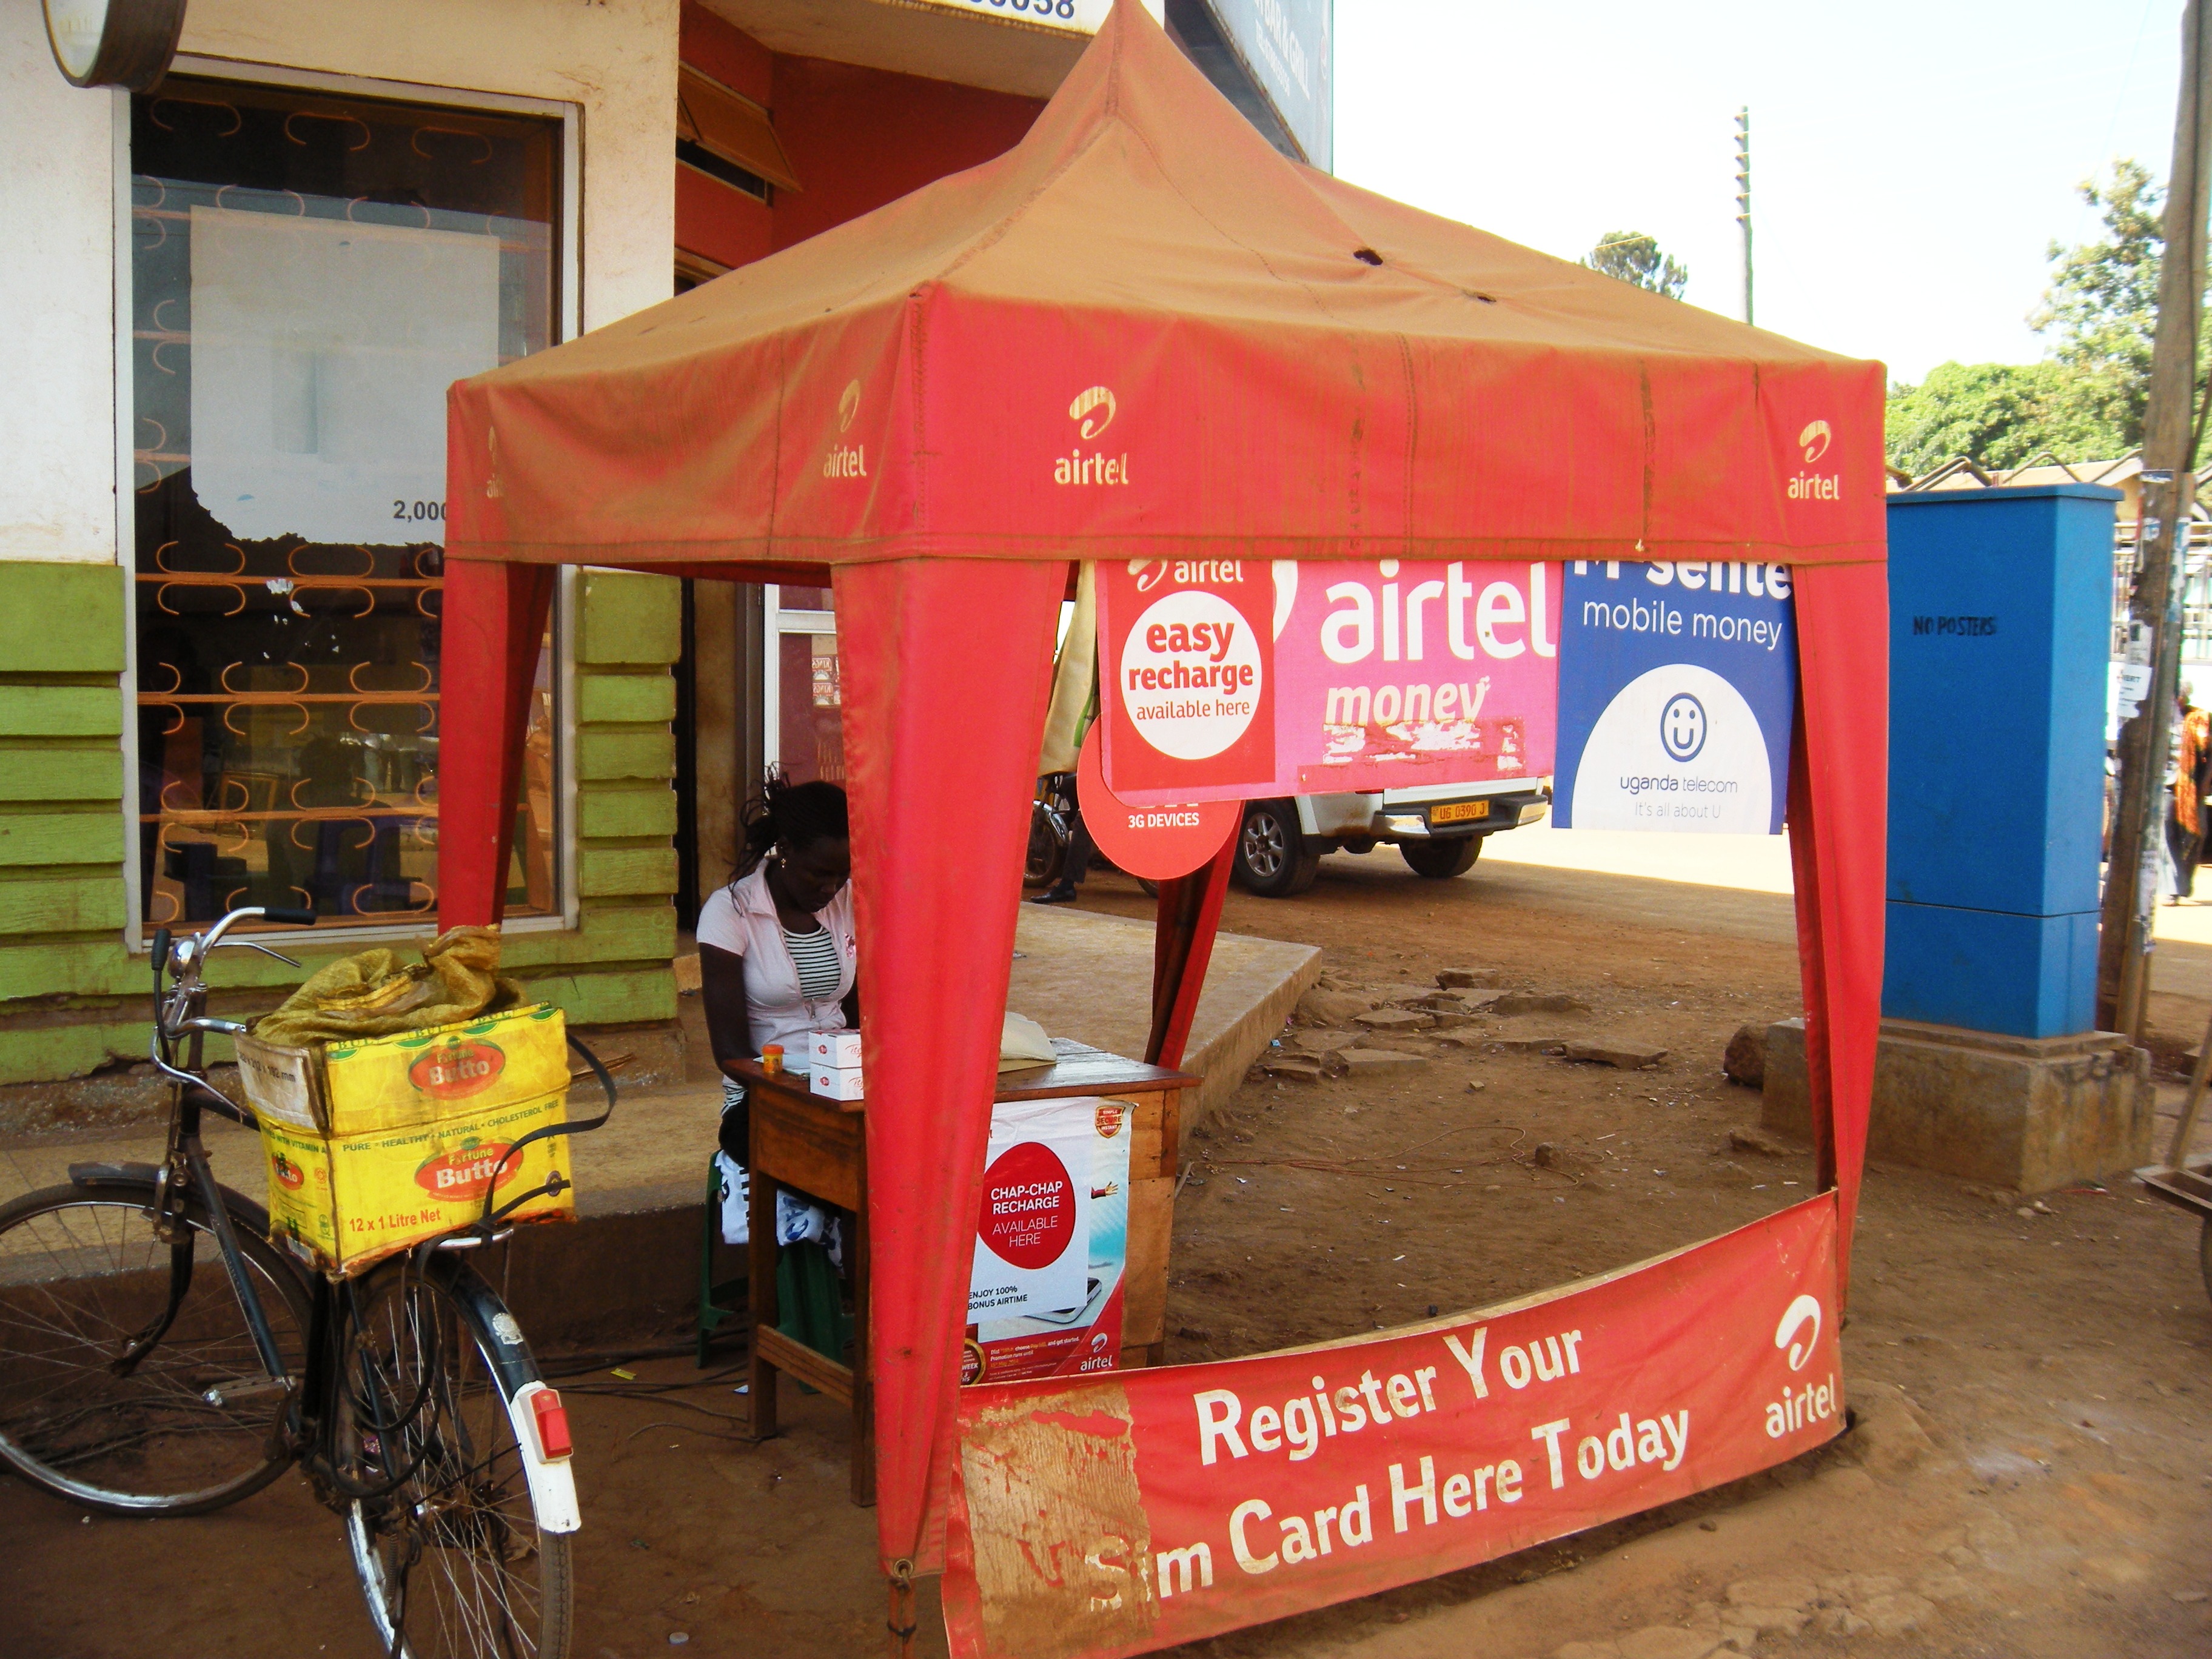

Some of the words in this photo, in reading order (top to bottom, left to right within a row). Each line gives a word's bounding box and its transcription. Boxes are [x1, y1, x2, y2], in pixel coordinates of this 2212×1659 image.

[823, 443, 866, 478] airtel
[1054, 448, 1128, 484] airtel
[1788, 471, 1840, 500] airtel
[1174, 559, 1244, 583] airtel
[1321, 559, 1557, 664] airtel
[1583, 597, 1683, 634] mobile
[1693, 612, 1783, 651] money
[1914, 615, 1934, 635] NO
[1937, 615, 1997, 636] POSTERS
[1146, 622, 1235, 662] easy
[1128, 660, 1253, 695] recharge
[1136, 701, 1210, 720] available
[1216, 699, 1250, 716] here
[1620, 774, 1678, 795] uganda
[1683, 776, 1738, 793] telecom
[1128, 814, 1145, 828] 3G
[1147, 812, 1200, 828] DEVICES
[1440, 807, 1451, 820] UG
[1455, 804, 1476, 818] 0390
[1480, 803, 1485, 815] J
[1635, 802, 1652, 816] It's
[1657, 804, 1669, 817] all
[1674, 803, 1708, 818] about
[1712, 805, 1721, 819] U
[428, 1060, 490, 1086] Butto
[343, 1142, 371, 1152] PURE
[382, 1134, 429, 1148] HEALTHY
[438, 1123, 480, 1139] NATURAL
[487, 1107, 543, 1127] CHOLESTEROL
[544, 1099, 559, 1111] FREE
[1096, 1115, 1122, 1124] SECURE
[290, 1139, 319, 1153] VITAMIN
[449, 1148, 494, 1165] Fortune
[437, 1159, 508, 1189] Butto
[991, 1181, 1063, 1201] CHAP-CHAP
[993, 1196, 1059, 1215] RECHARGE
[349, 1219, 364, 1233] 12
[367, 1219, 375, 1231] x
[378, 1216, 385, 1229] 1
[389, 1214, 417, 1228] Litre
[420, 1208, 441, 1223] Net
[993, 1215, 1058, 1235] AVAILABLE
[1009, 1232, 1041, 1247] HERE
[996, 1285, 1017, 1295] 100%
[997, 1294, 1028, 1305] AIRTIME
[1080, 1355, 1113, 1371] airtel
[1193, 1366, 1436, 1466] Register
[1443, 1327, 1582, 1399] Your
[1765, 1373, 1836, 1439] airtel
[1228, 1484, 1372, 1575] Card
[1389, 1455, 1523, 1533] Here
[1531, 1409, 1689, 1490] Today
